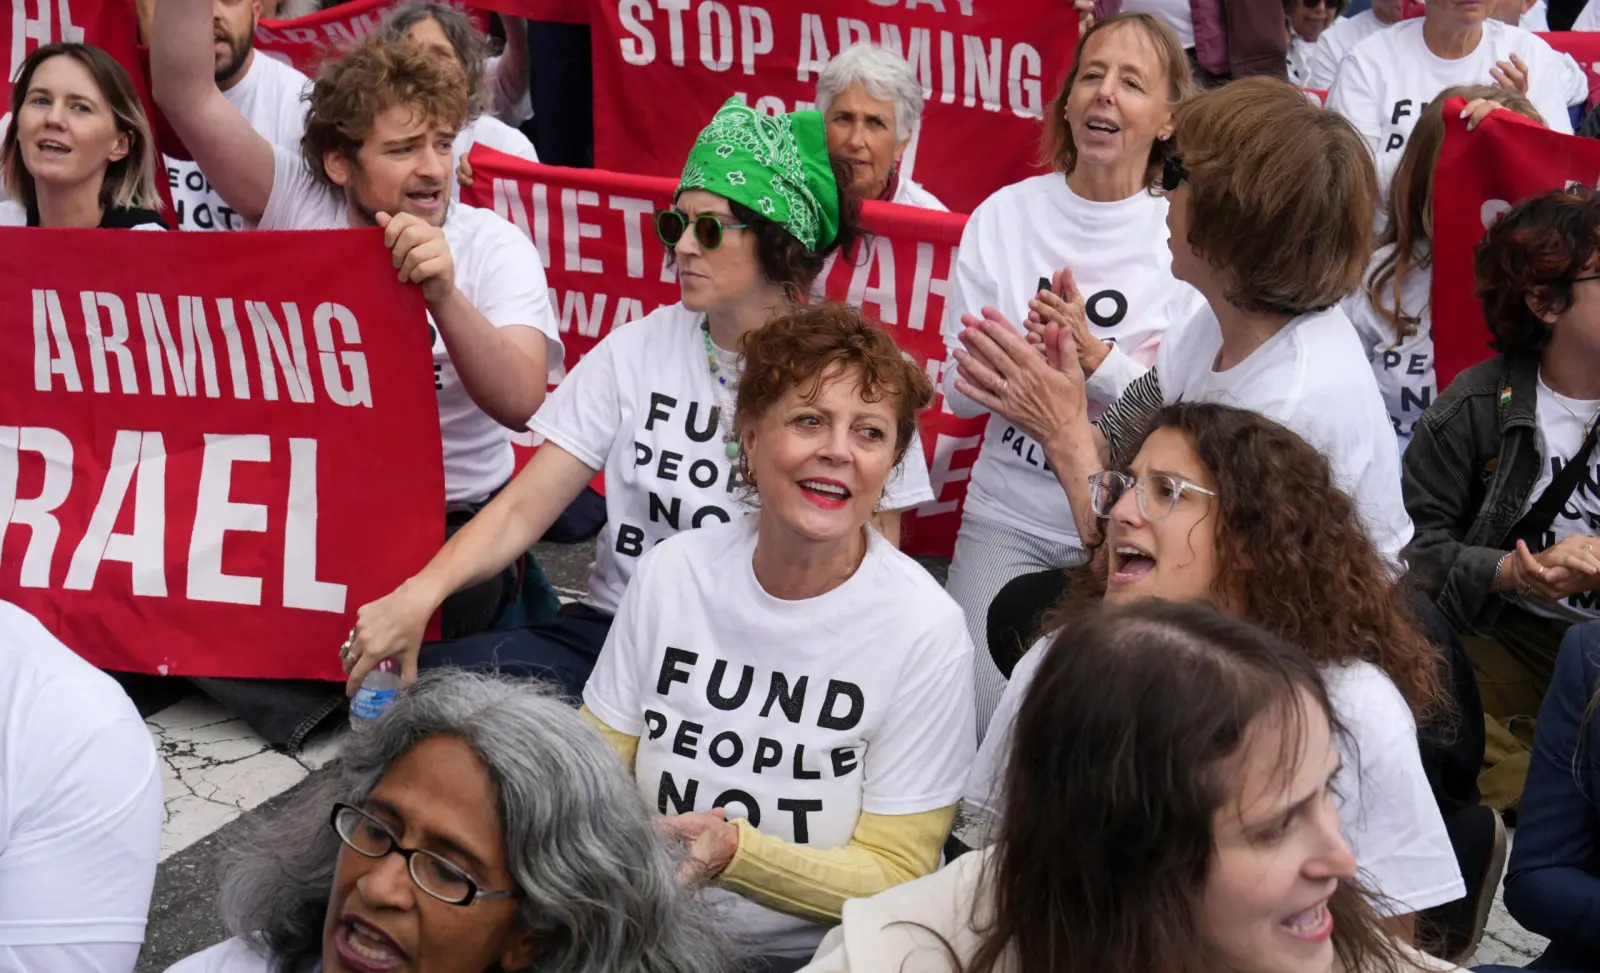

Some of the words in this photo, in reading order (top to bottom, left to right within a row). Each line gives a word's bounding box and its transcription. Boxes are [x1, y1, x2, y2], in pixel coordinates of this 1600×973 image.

[618, 0, 775, 75] STOP
[31, 288, 374, 408] ARMING
[0, 425, 348, 614] RAEL
[656, 646, 865, 731] FUND
[644, 709, 857, 780] PEOPLE
[657, 770, 823, 844] NOT
